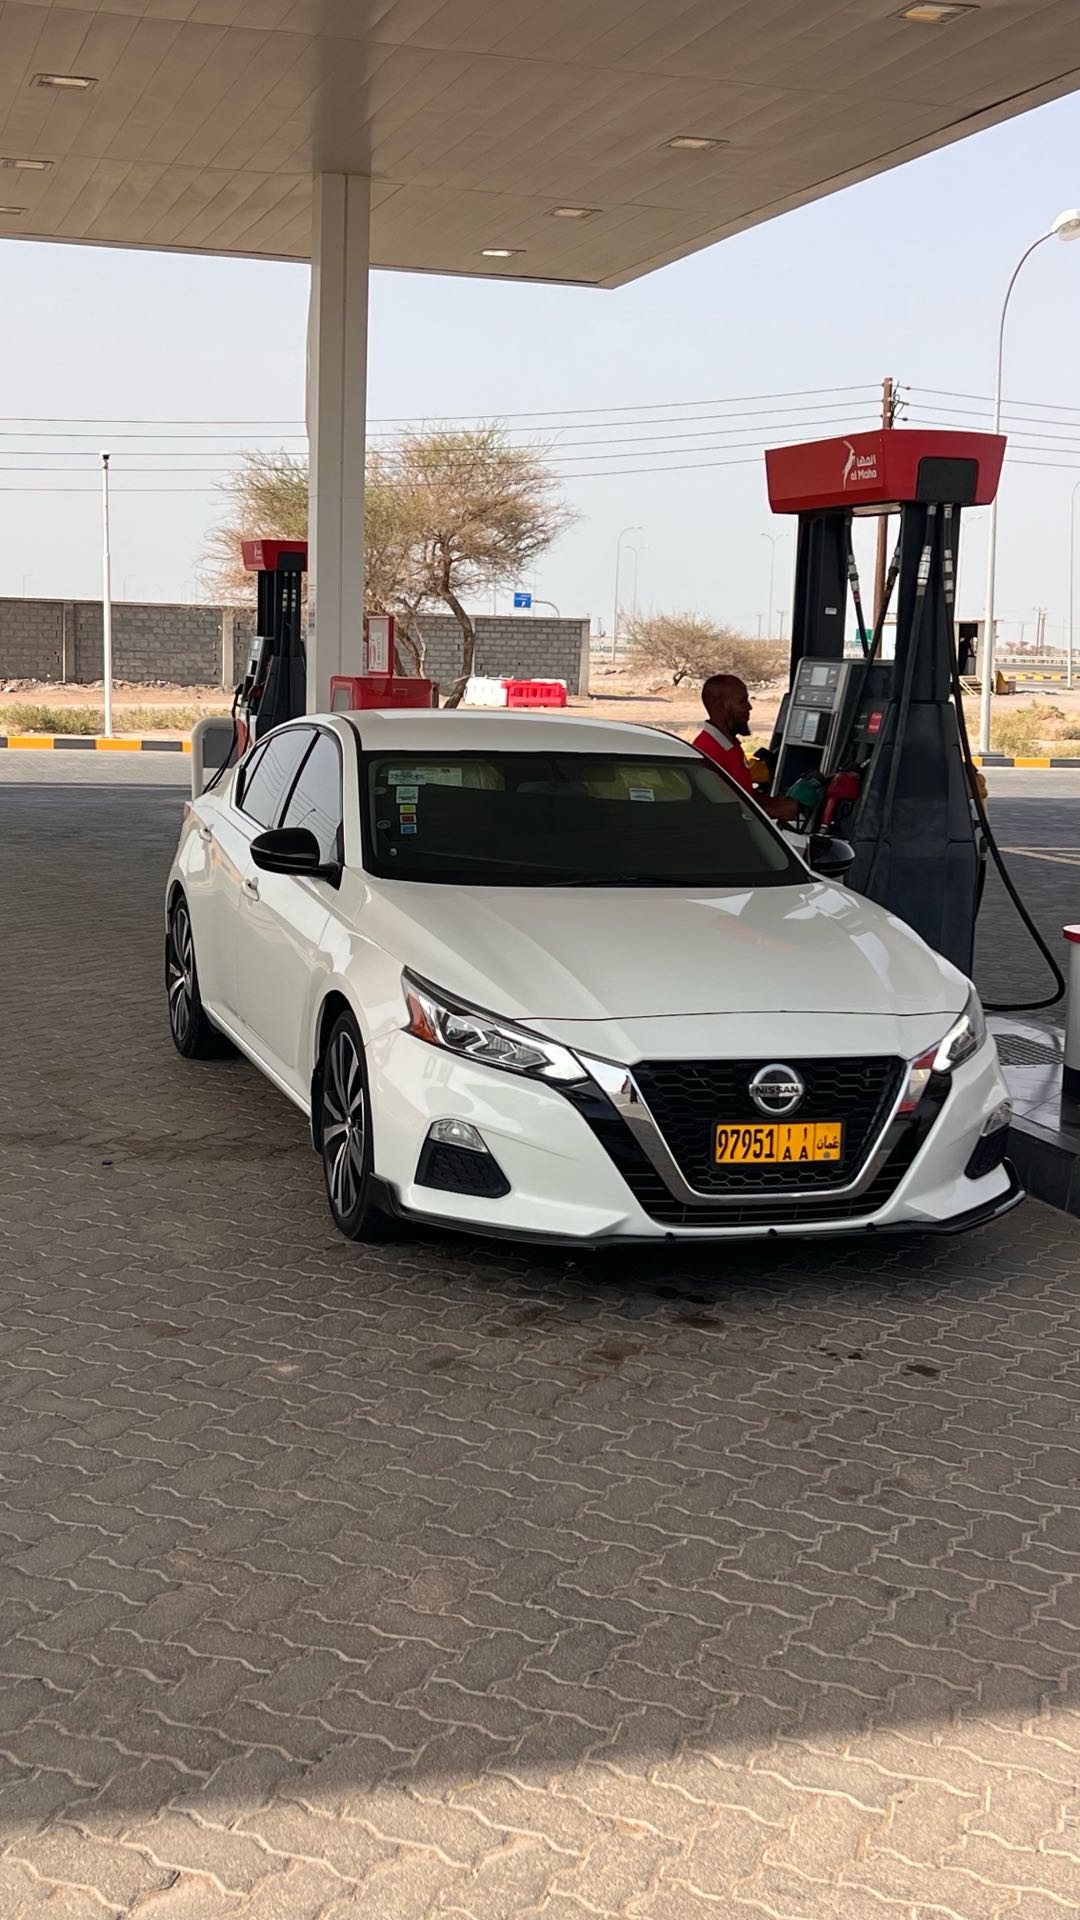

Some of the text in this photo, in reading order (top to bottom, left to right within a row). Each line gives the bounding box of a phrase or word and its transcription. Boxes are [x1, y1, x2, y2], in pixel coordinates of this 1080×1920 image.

[850, 470, 857, 480] al
[755, 1085, 799, 1095] NISSAN
[718, 1128, 774, 1159] 97951
